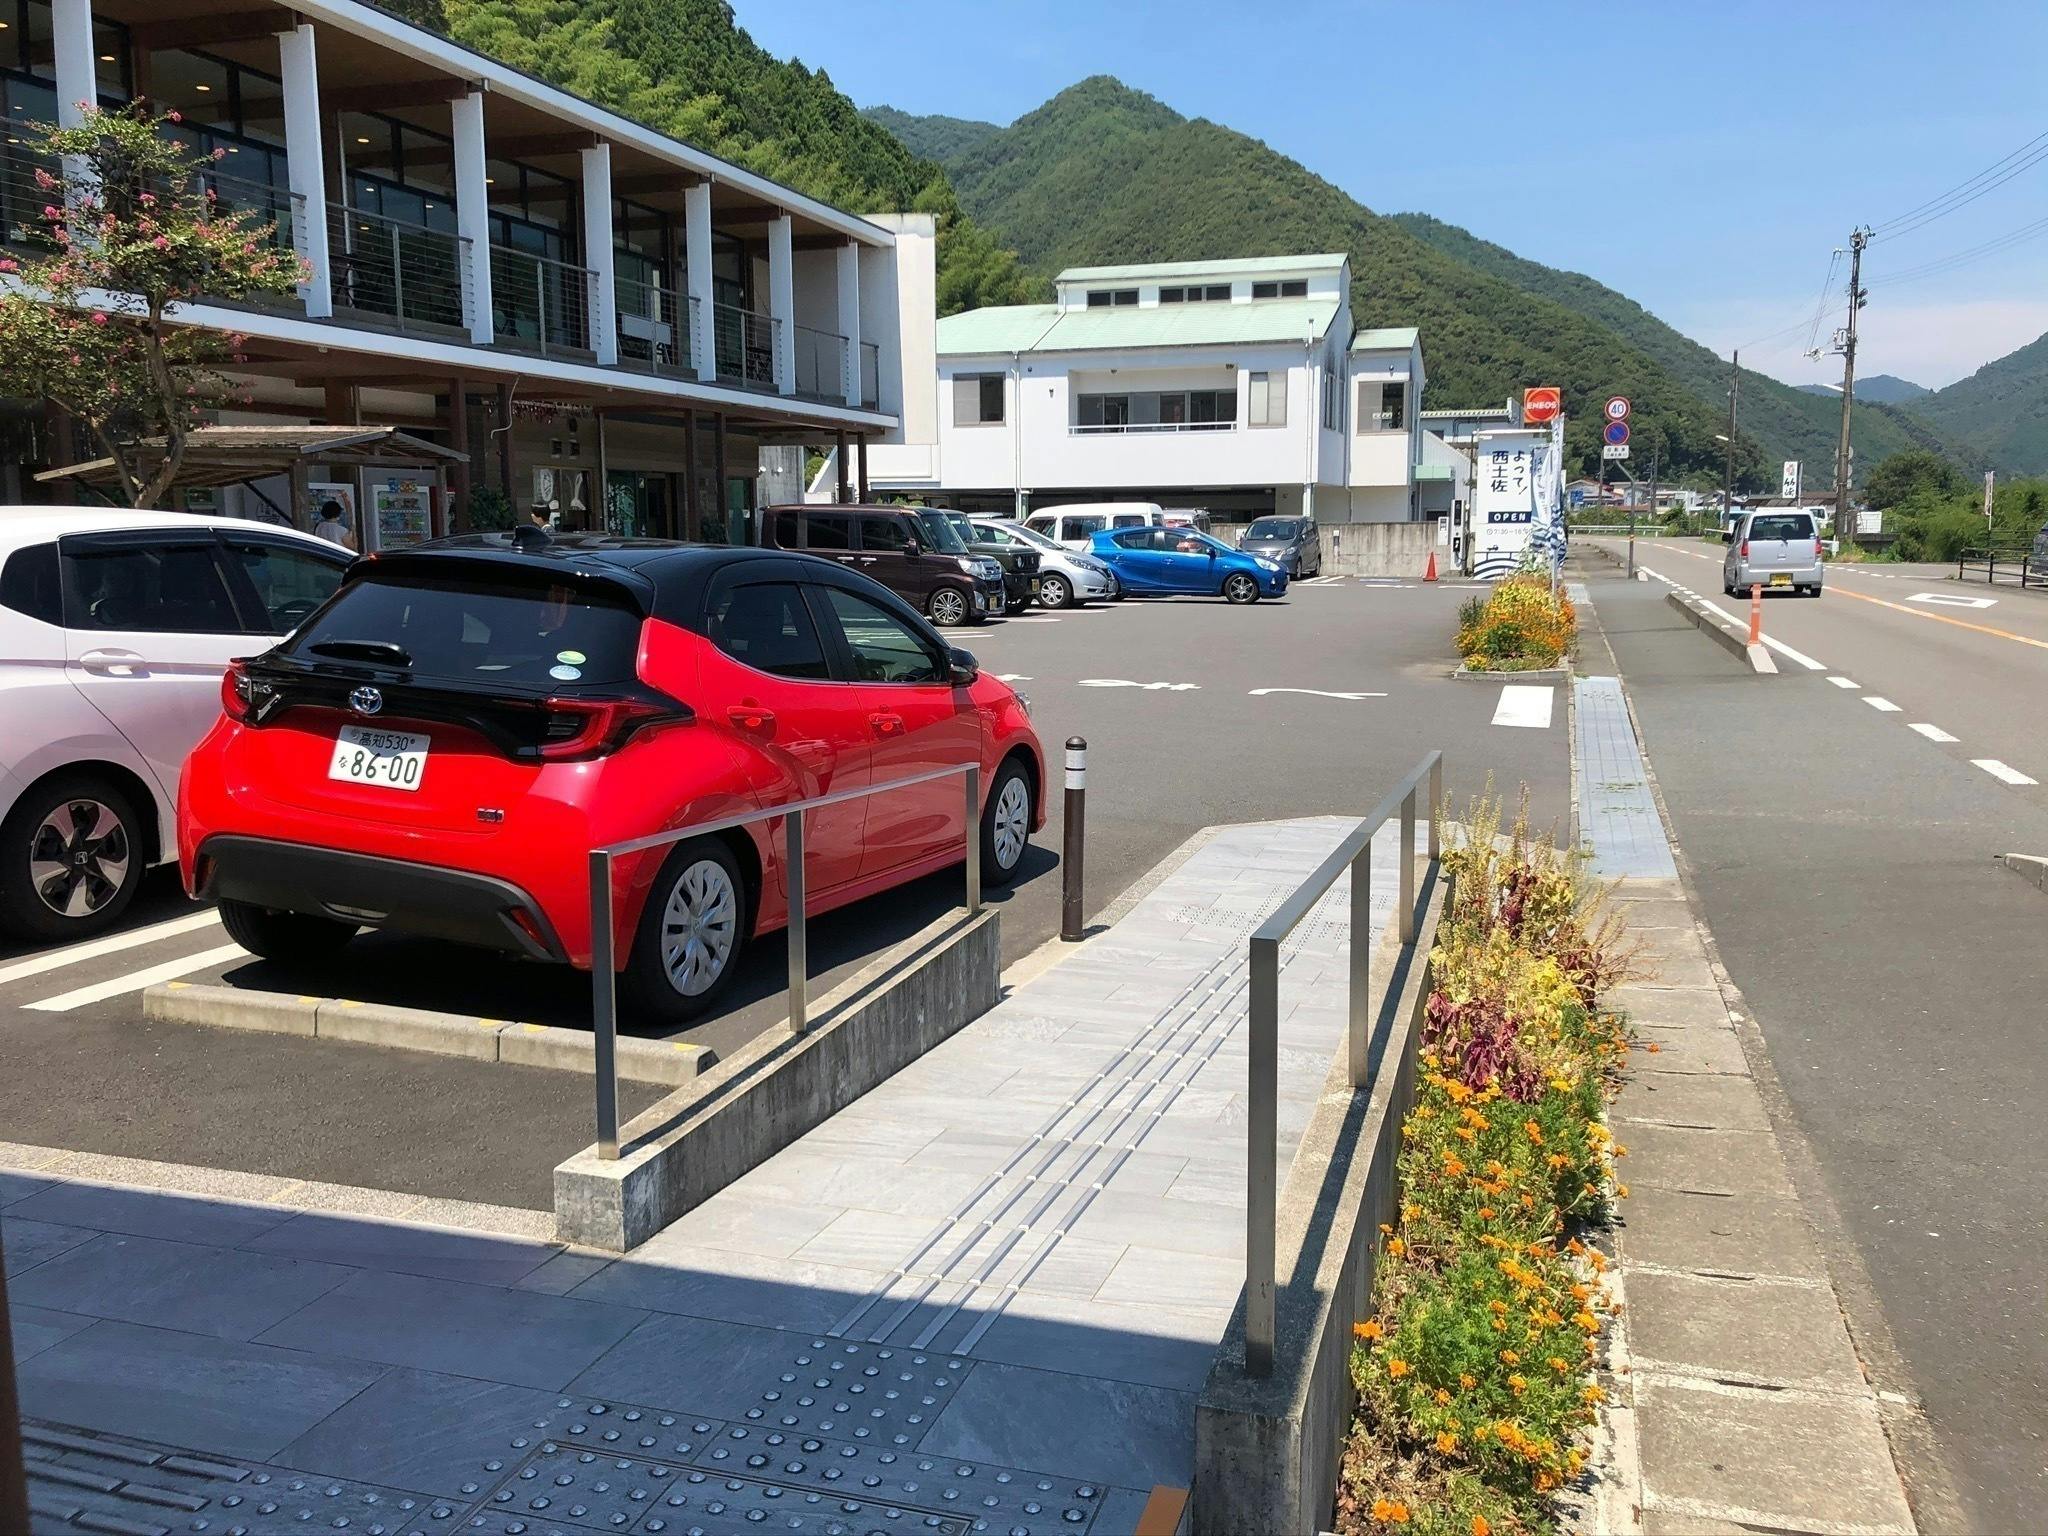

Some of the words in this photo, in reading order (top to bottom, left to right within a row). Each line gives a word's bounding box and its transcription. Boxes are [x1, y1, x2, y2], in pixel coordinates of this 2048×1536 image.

[1526, 401, 1557, 410] ENEOS
[1611, 403, 1625, 415] 40
[1491, 450, 1509, 493] 西土佐
[1493, 512, 1526, 522] OPEN
[351, 750, 418, 784] 86-00
